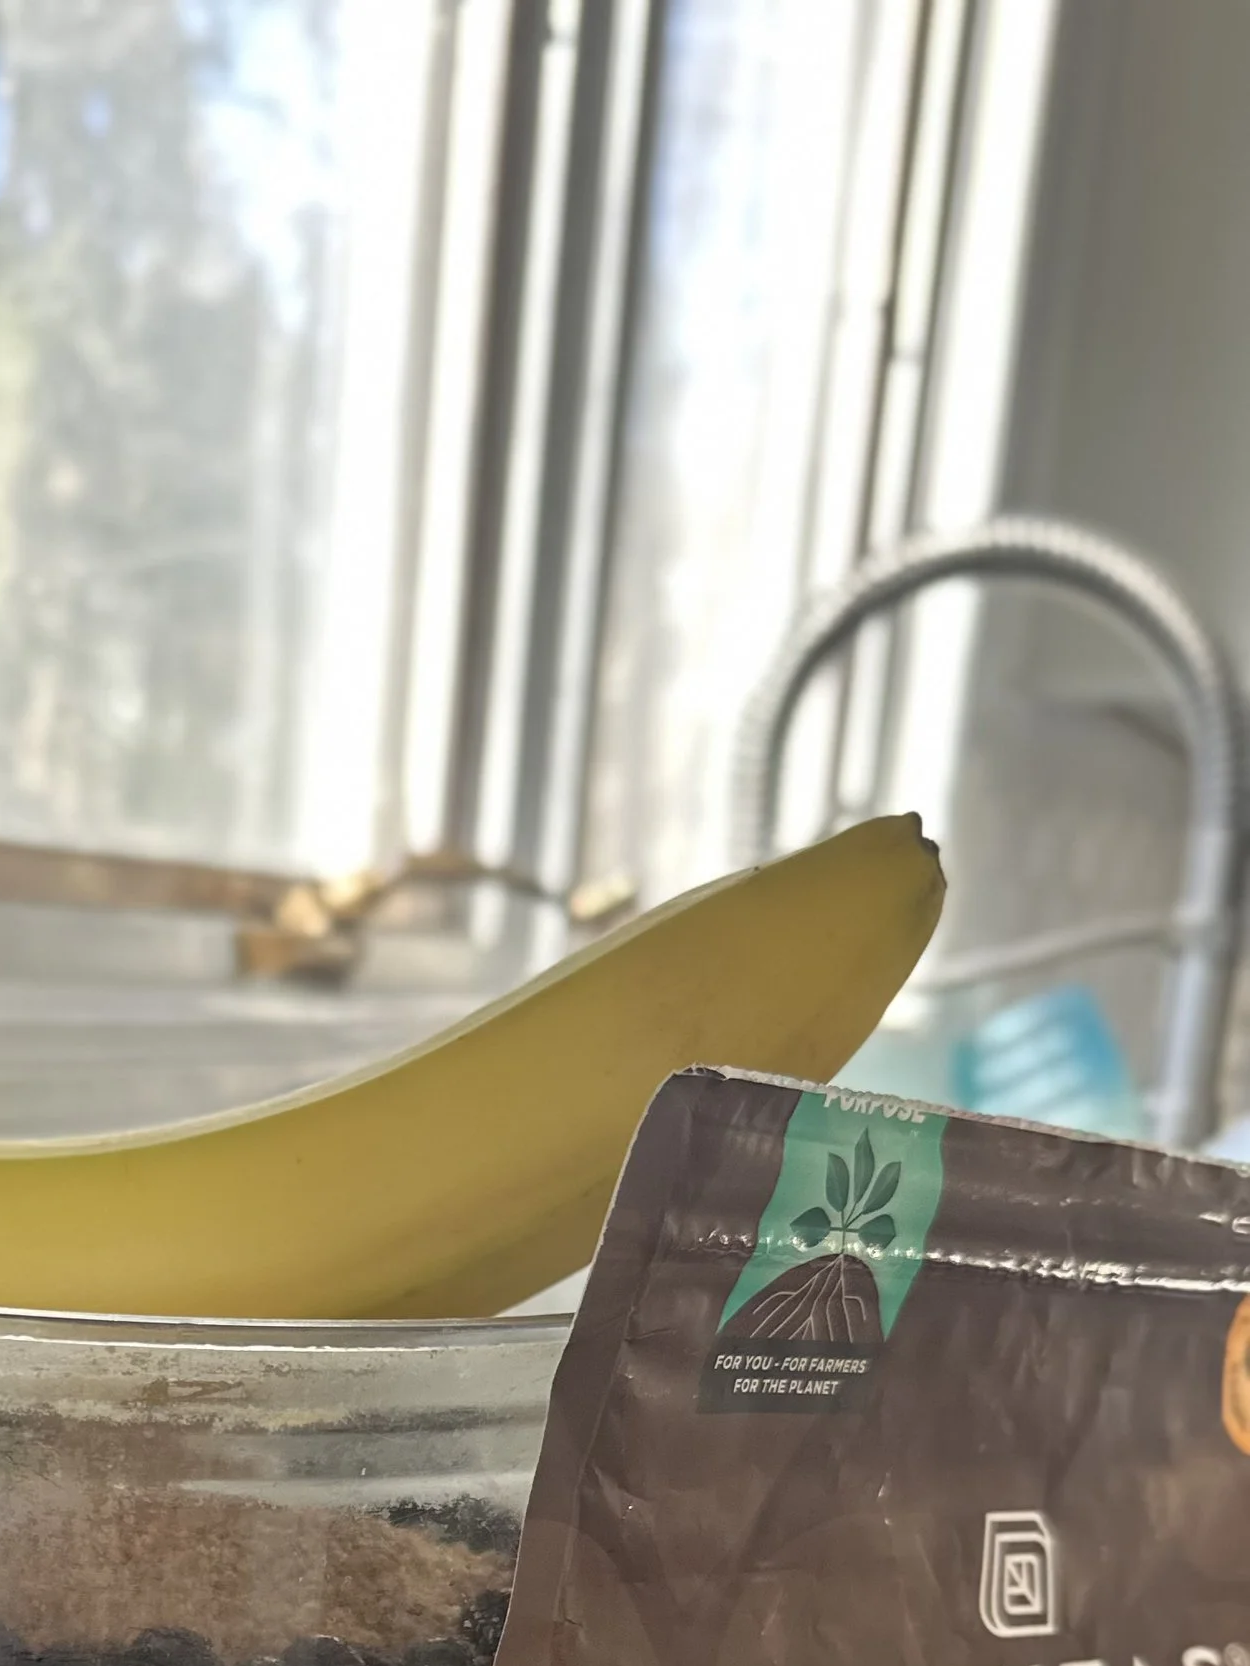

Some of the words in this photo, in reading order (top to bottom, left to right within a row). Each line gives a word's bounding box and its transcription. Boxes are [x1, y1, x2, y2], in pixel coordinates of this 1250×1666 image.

[714, 1354, 743, 1370] FOR
[744, 1355, 774, 1371] YOU
[780, 1357, 808, 1372] FOR
[808, 1358, 867, 1374] FARMERS
[733, 1378, 759, 1394] FOR
[761, 1379, 787, 1394] THE
[788, 1380, 839, 1395] PLANET
